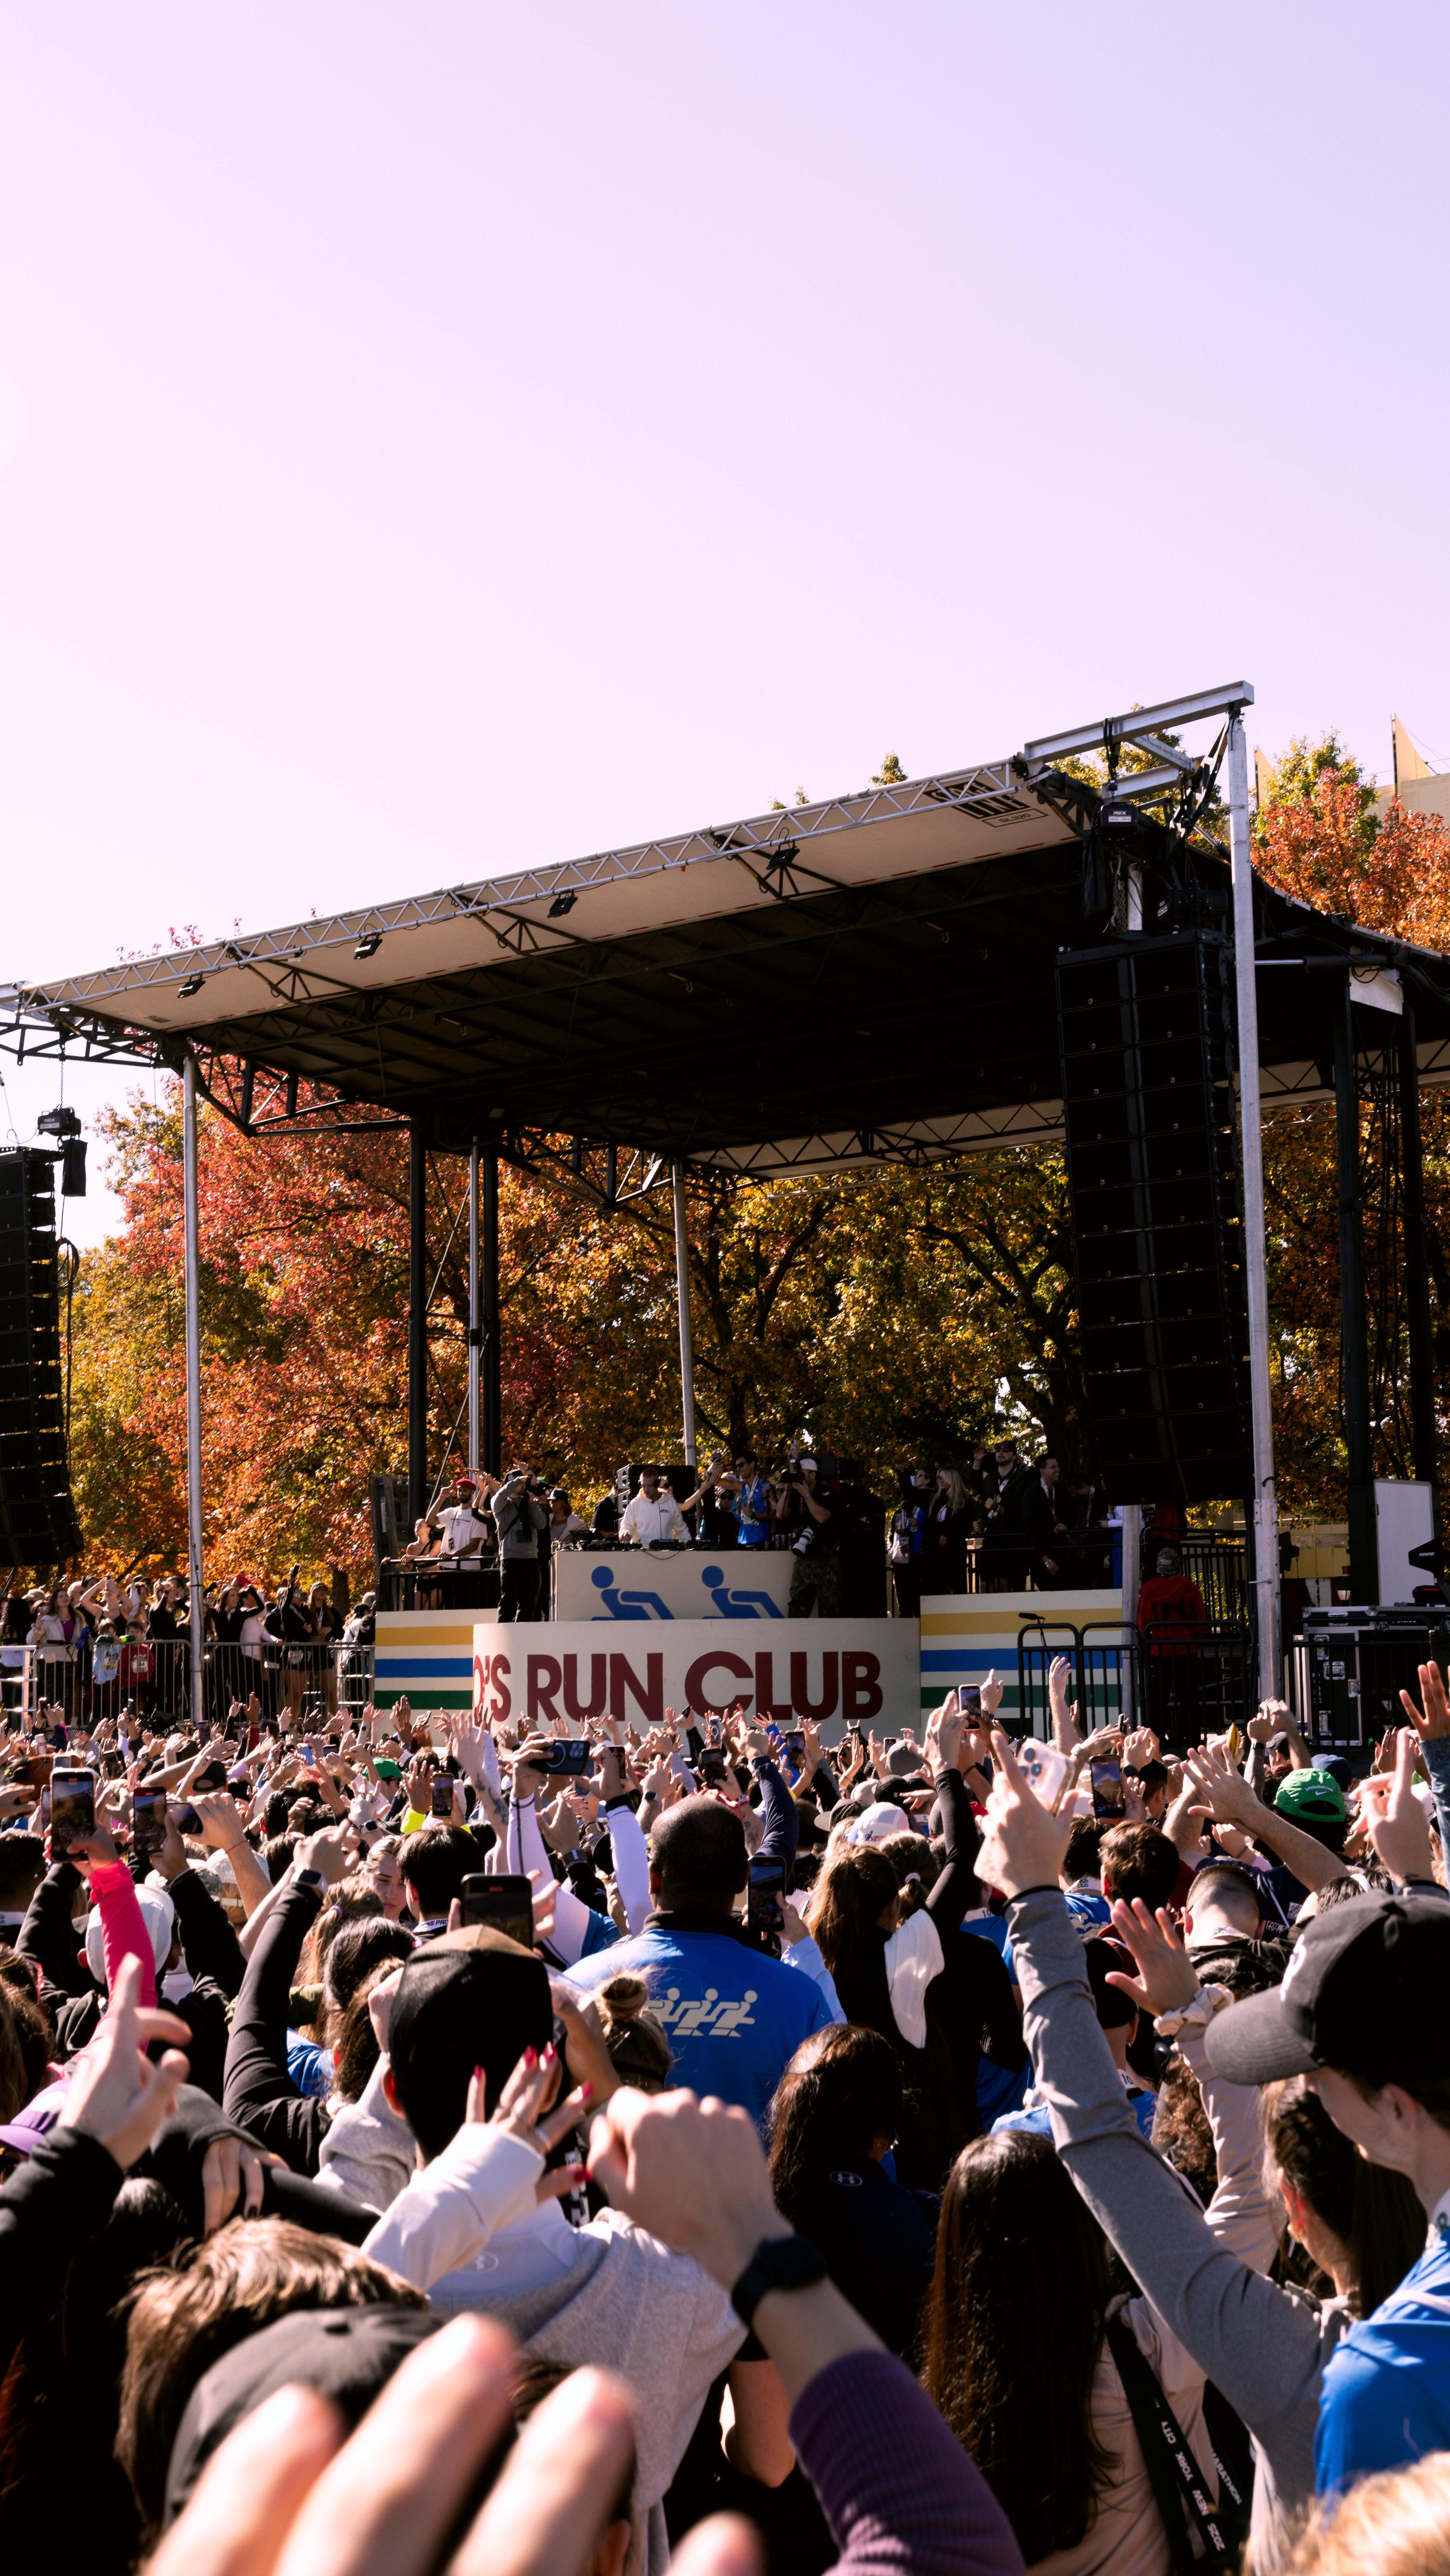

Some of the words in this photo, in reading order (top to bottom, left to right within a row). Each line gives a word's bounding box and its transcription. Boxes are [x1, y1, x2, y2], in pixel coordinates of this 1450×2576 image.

[955, 796, 1024, 817] LINE
[999, 814, 1030, 822] SL320
[533, 1652, 664, 1722] RUN
[684, 1651, 884, 1721] CLUB
[1268, 1922, 1280, 1930] FOX
[1161, 2420, 1176, 2444] CITY
[1175, 2451, 1194, 2482] YORK
[1192, 2489, 1210, 2516] NEW
[1207, 2522, 1226, 2552] 2025
